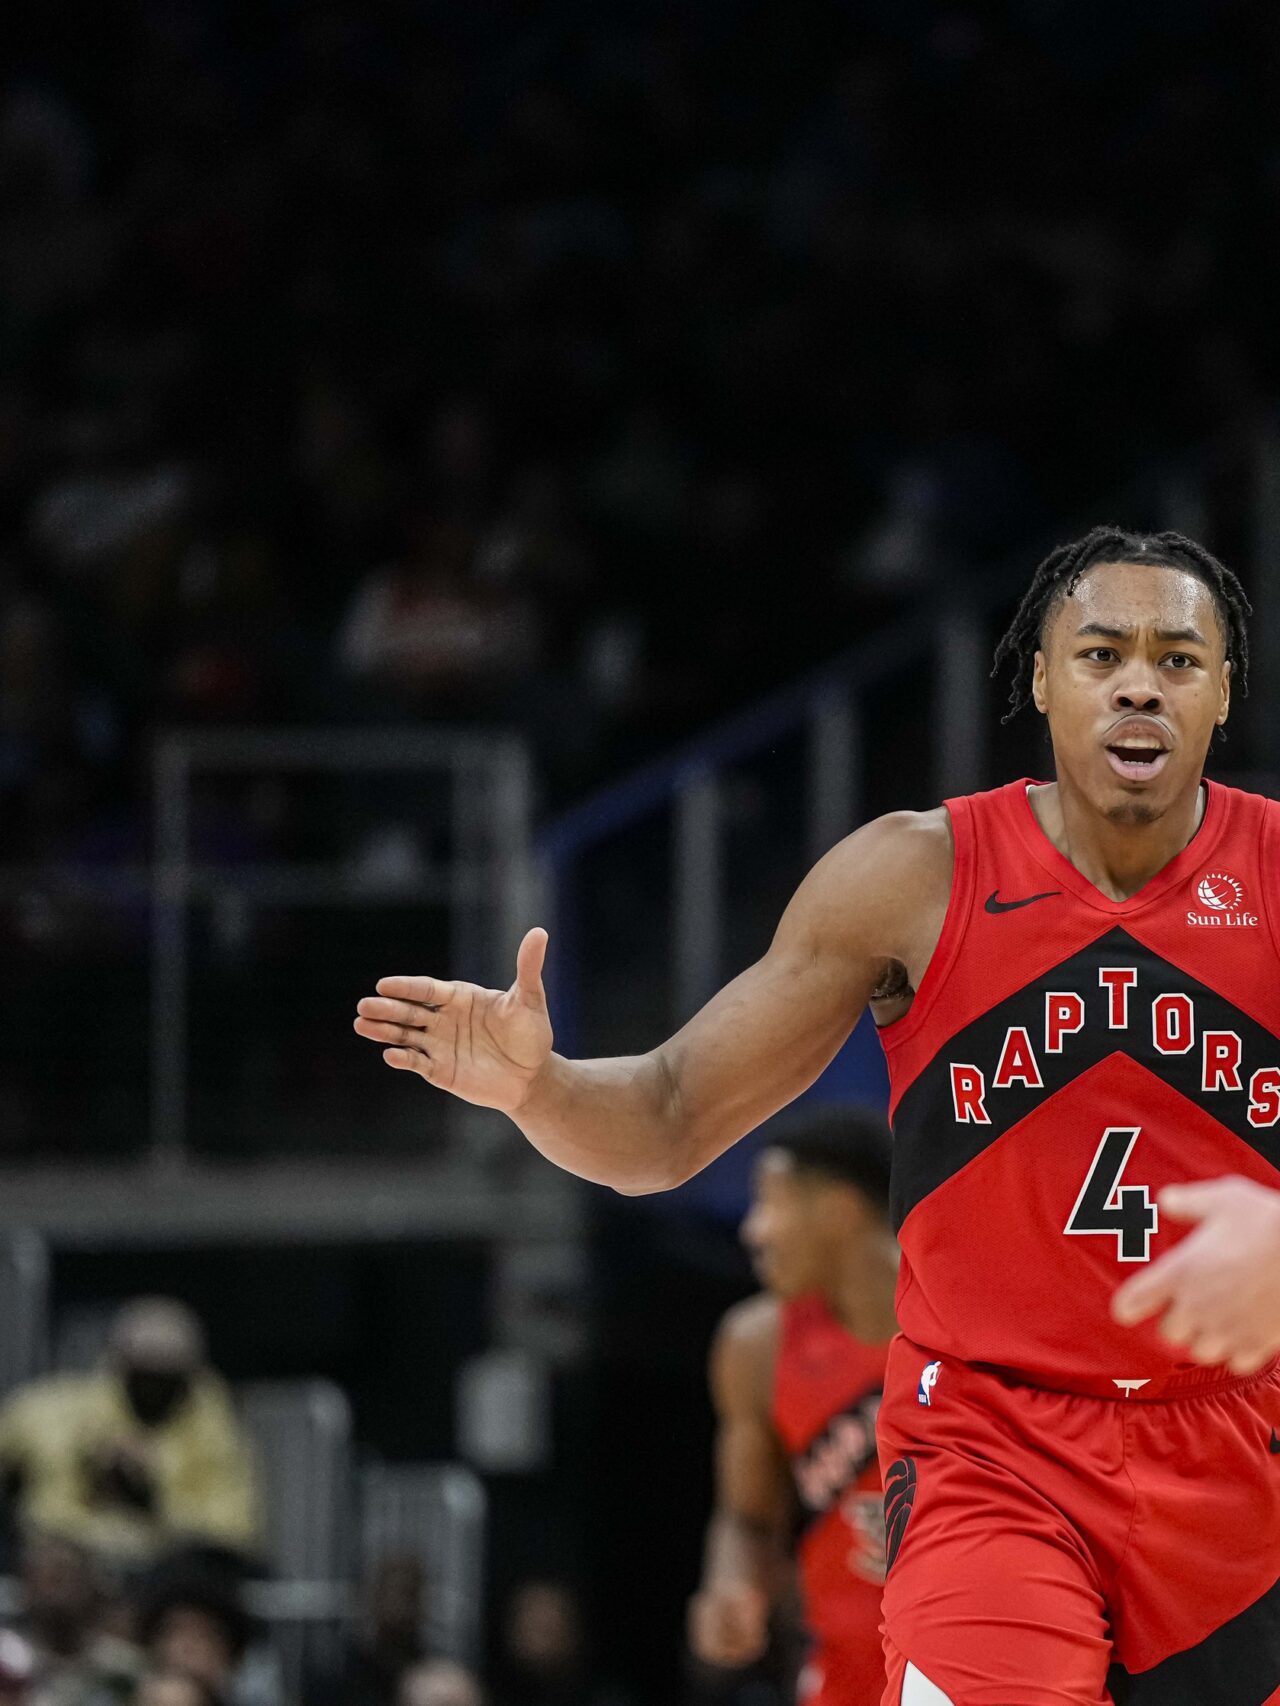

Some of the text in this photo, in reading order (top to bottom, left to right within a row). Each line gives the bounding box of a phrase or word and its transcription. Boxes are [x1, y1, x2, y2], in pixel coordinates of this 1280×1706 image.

[1187, 912, 1258, 926] Sun Life
[1063, 1127, 1158, 1262] 4
